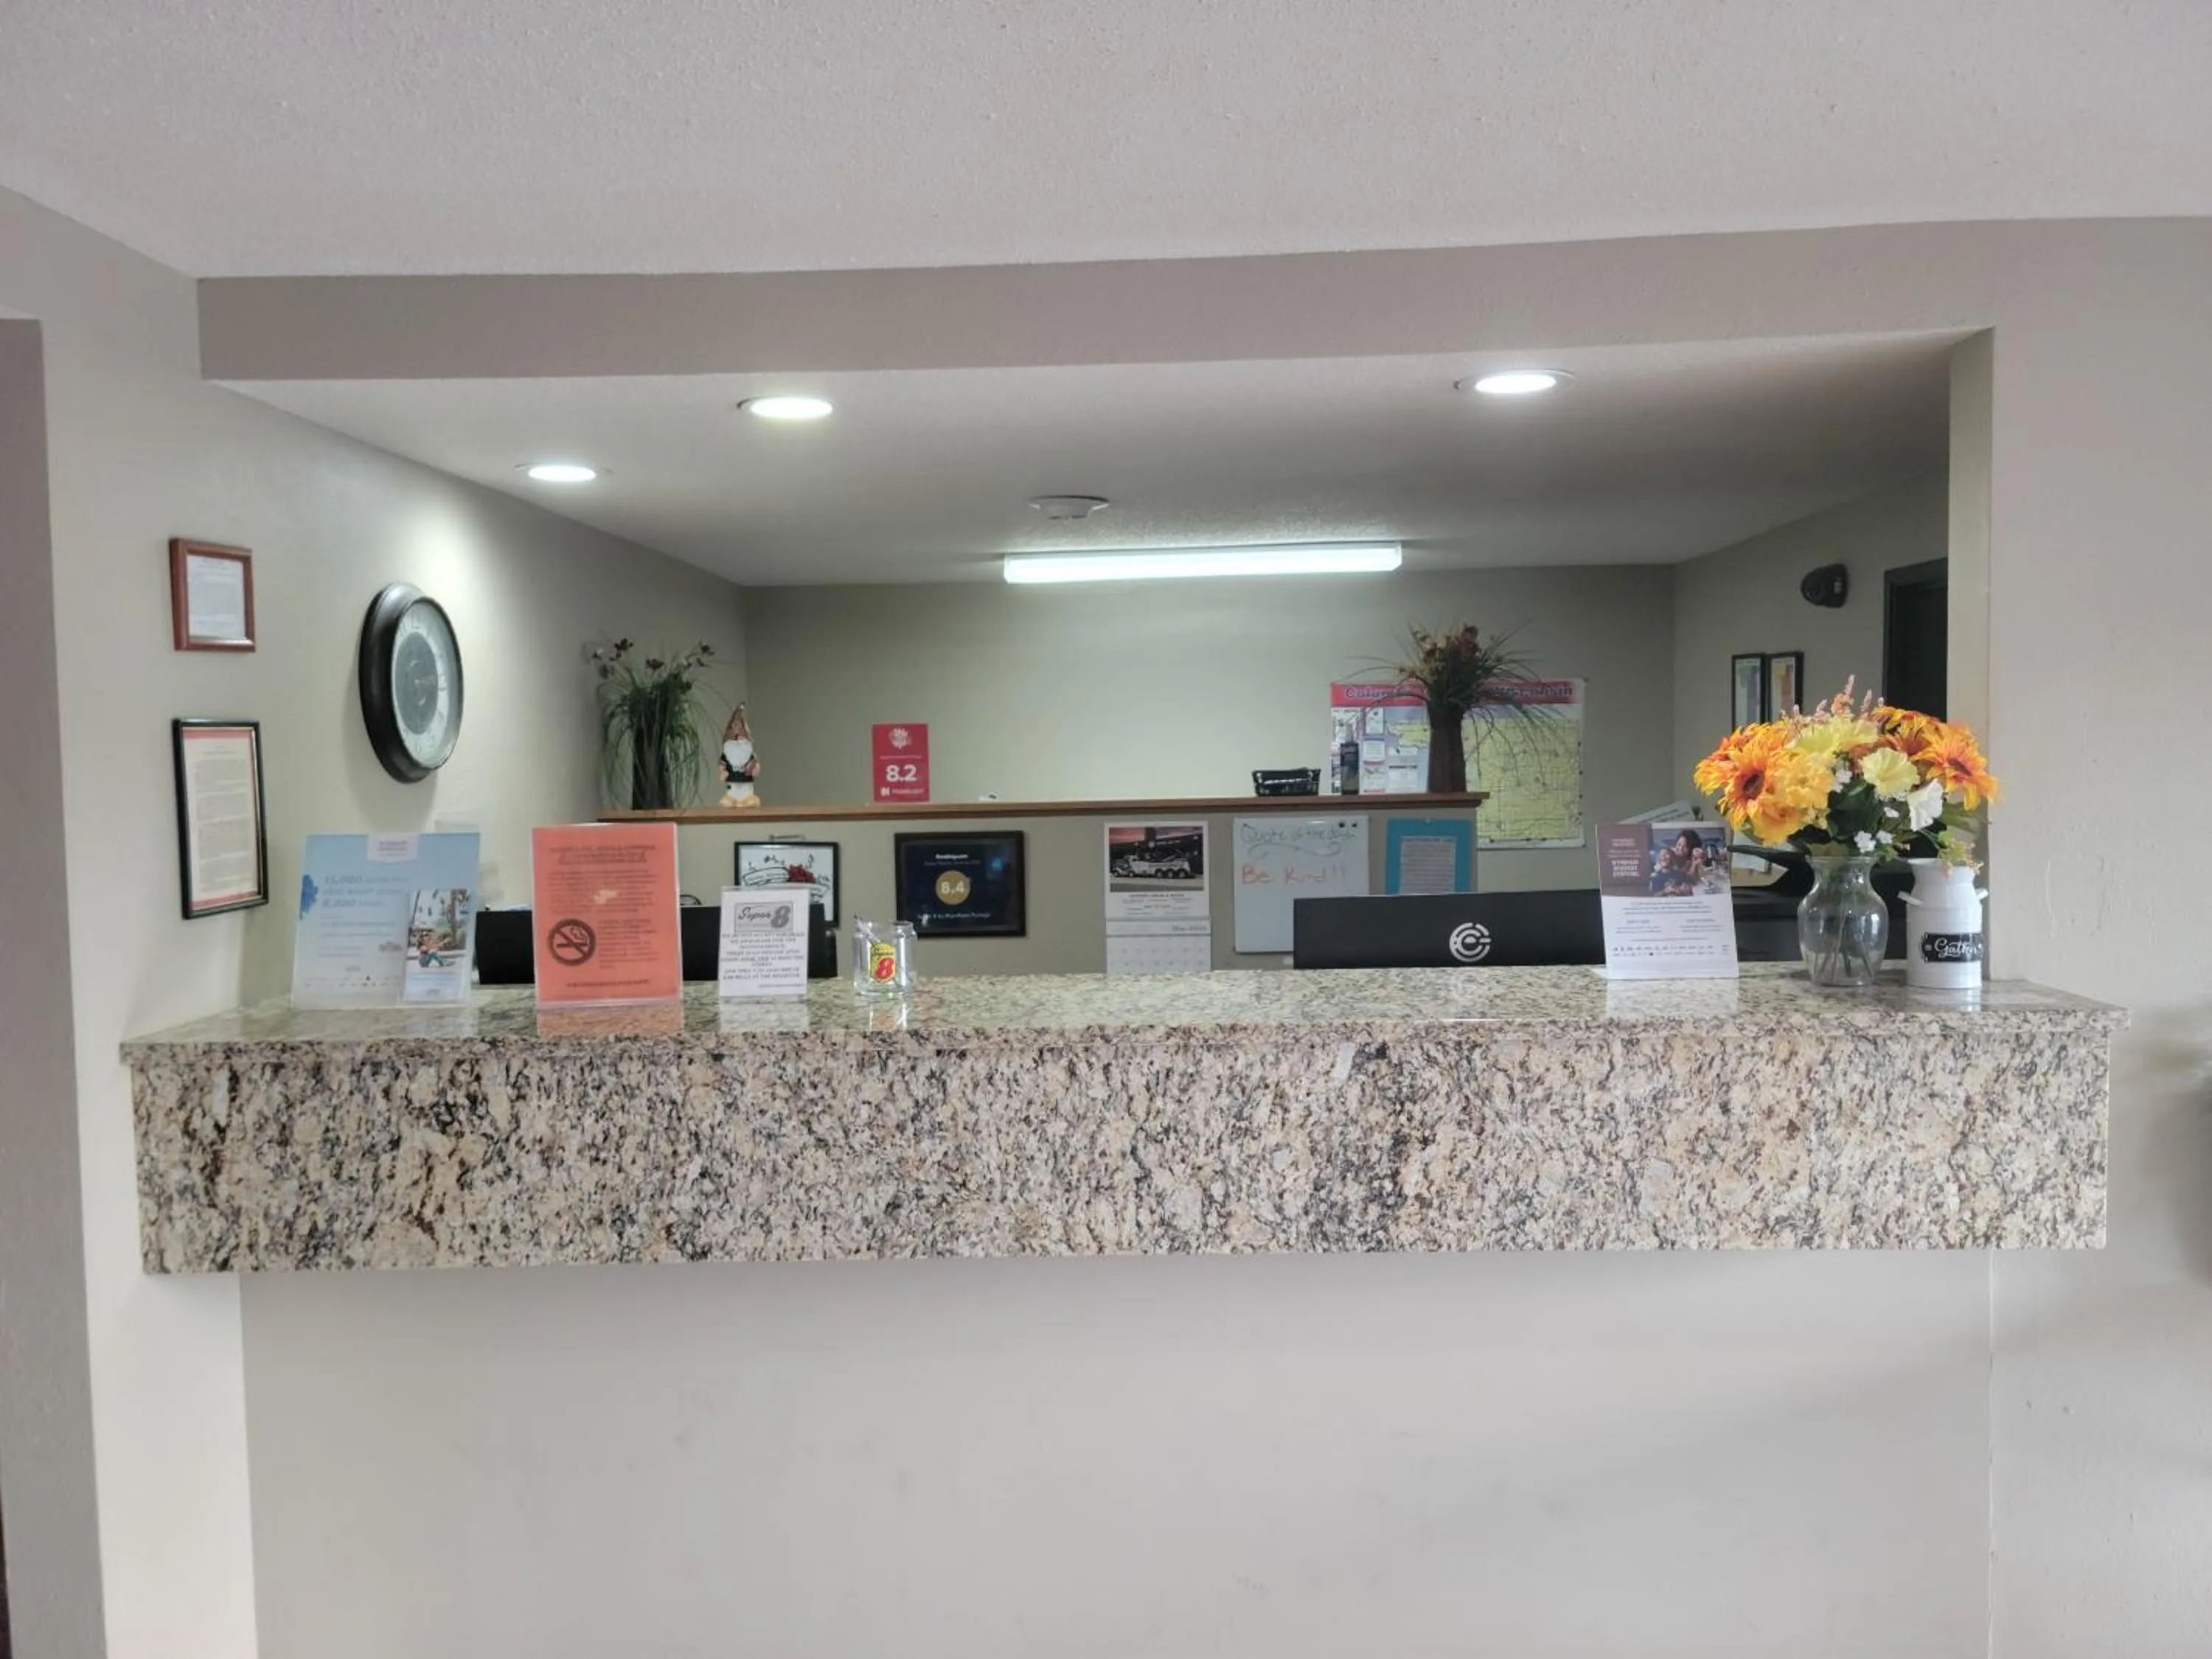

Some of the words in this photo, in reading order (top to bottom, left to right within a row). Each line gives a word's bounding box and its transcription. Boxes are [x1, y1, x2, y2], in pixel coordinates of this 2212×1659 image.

[885, 764, 917, 782] 8.2
[1242, 863, 1274, 884] Be
[941, 881, 964, 894] 8.4
[737, 905, 772, 921] Super
[771, 905, 791, 929] 8
[874, 957, 896, 981] 8
